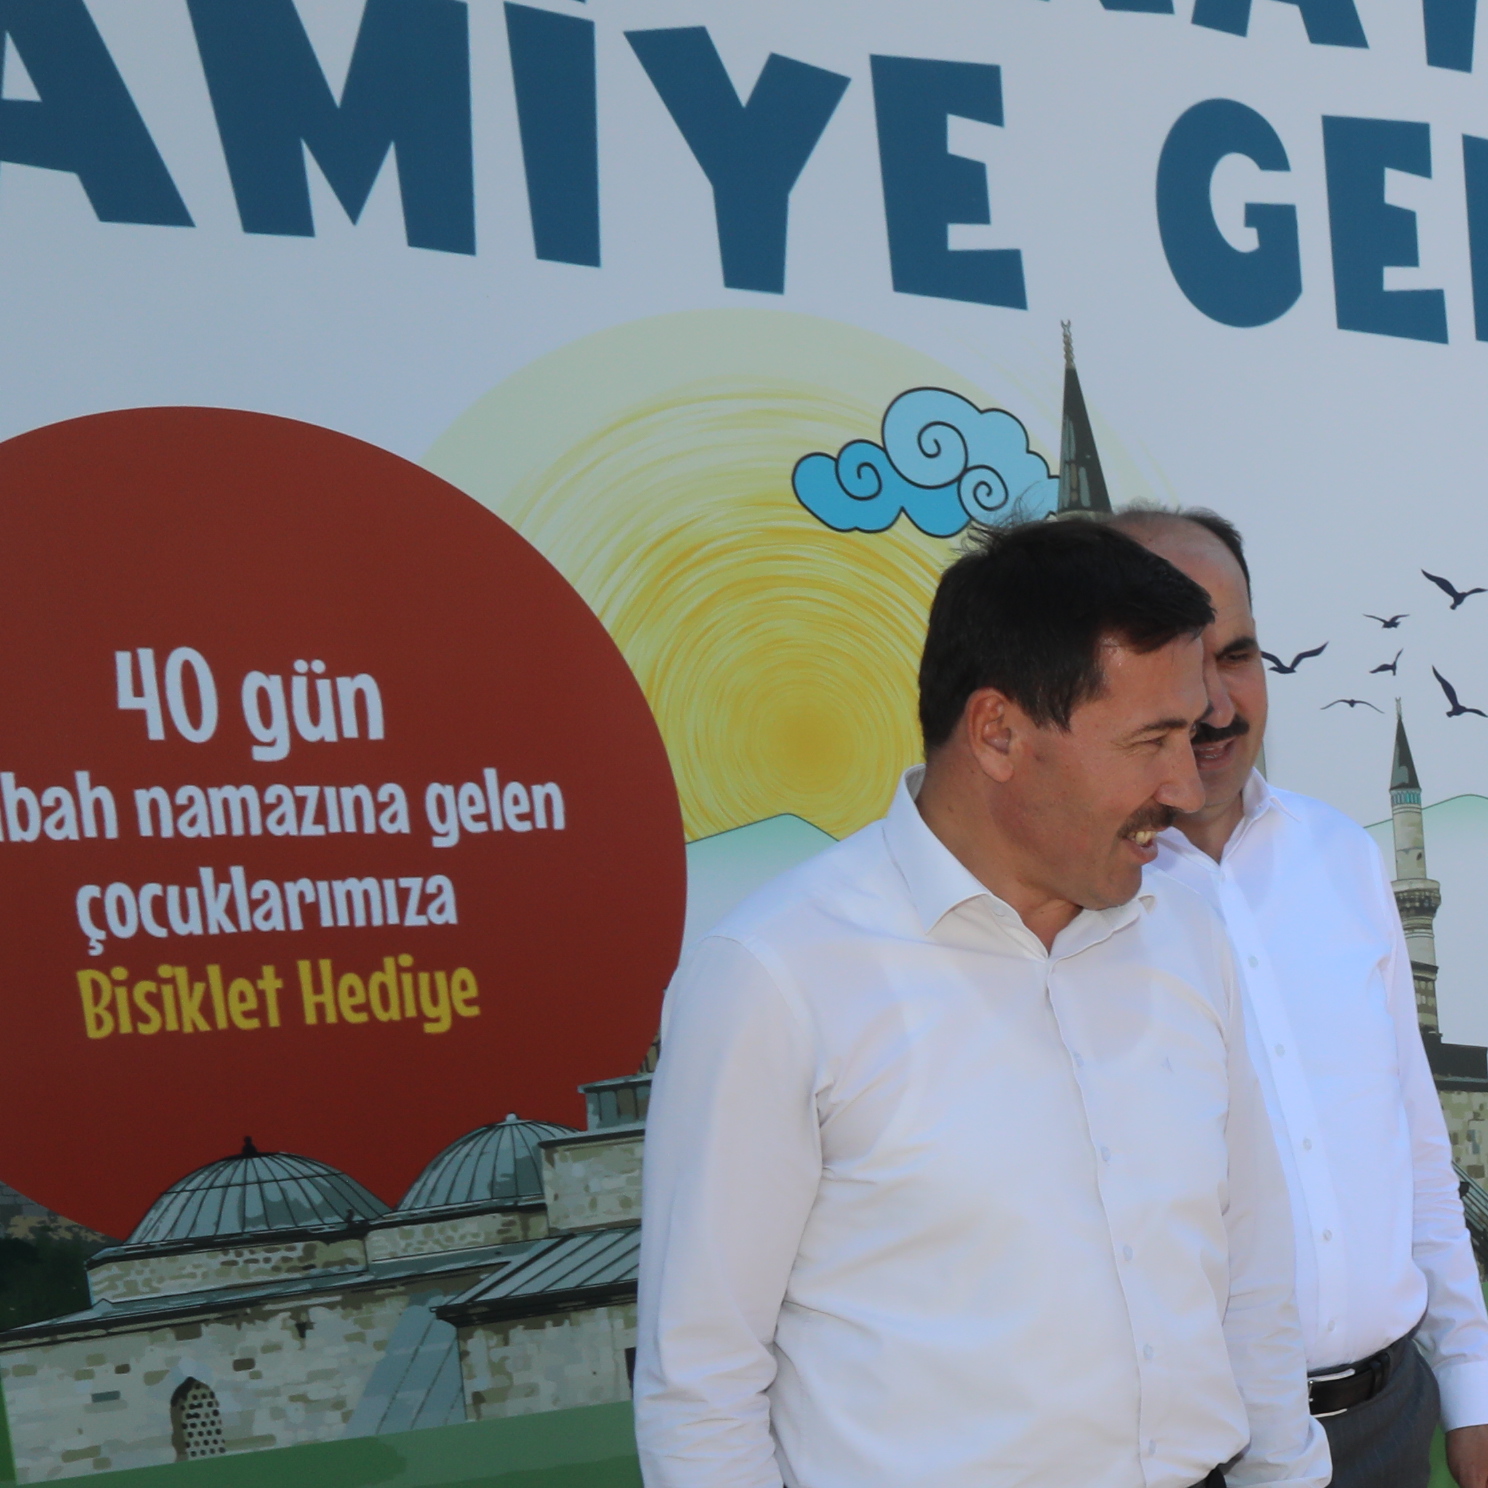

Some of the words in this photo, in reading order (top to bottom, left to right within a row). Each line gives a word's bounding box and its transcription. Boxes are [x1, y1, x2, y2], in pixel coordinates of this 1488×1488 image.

[115, 646, 219, 743] 40
[241, 658, 385, 762] gün
[0, 770, 118, 843] bah
[134, 780, 411, 838] namazına
[425, 767, 566, 848] gelen
[76, 865, 458, 956] çocuklarımıza
[76, 962, 284, 1039] Bisiklet
[298, 953, 481, 1033] Hediye
